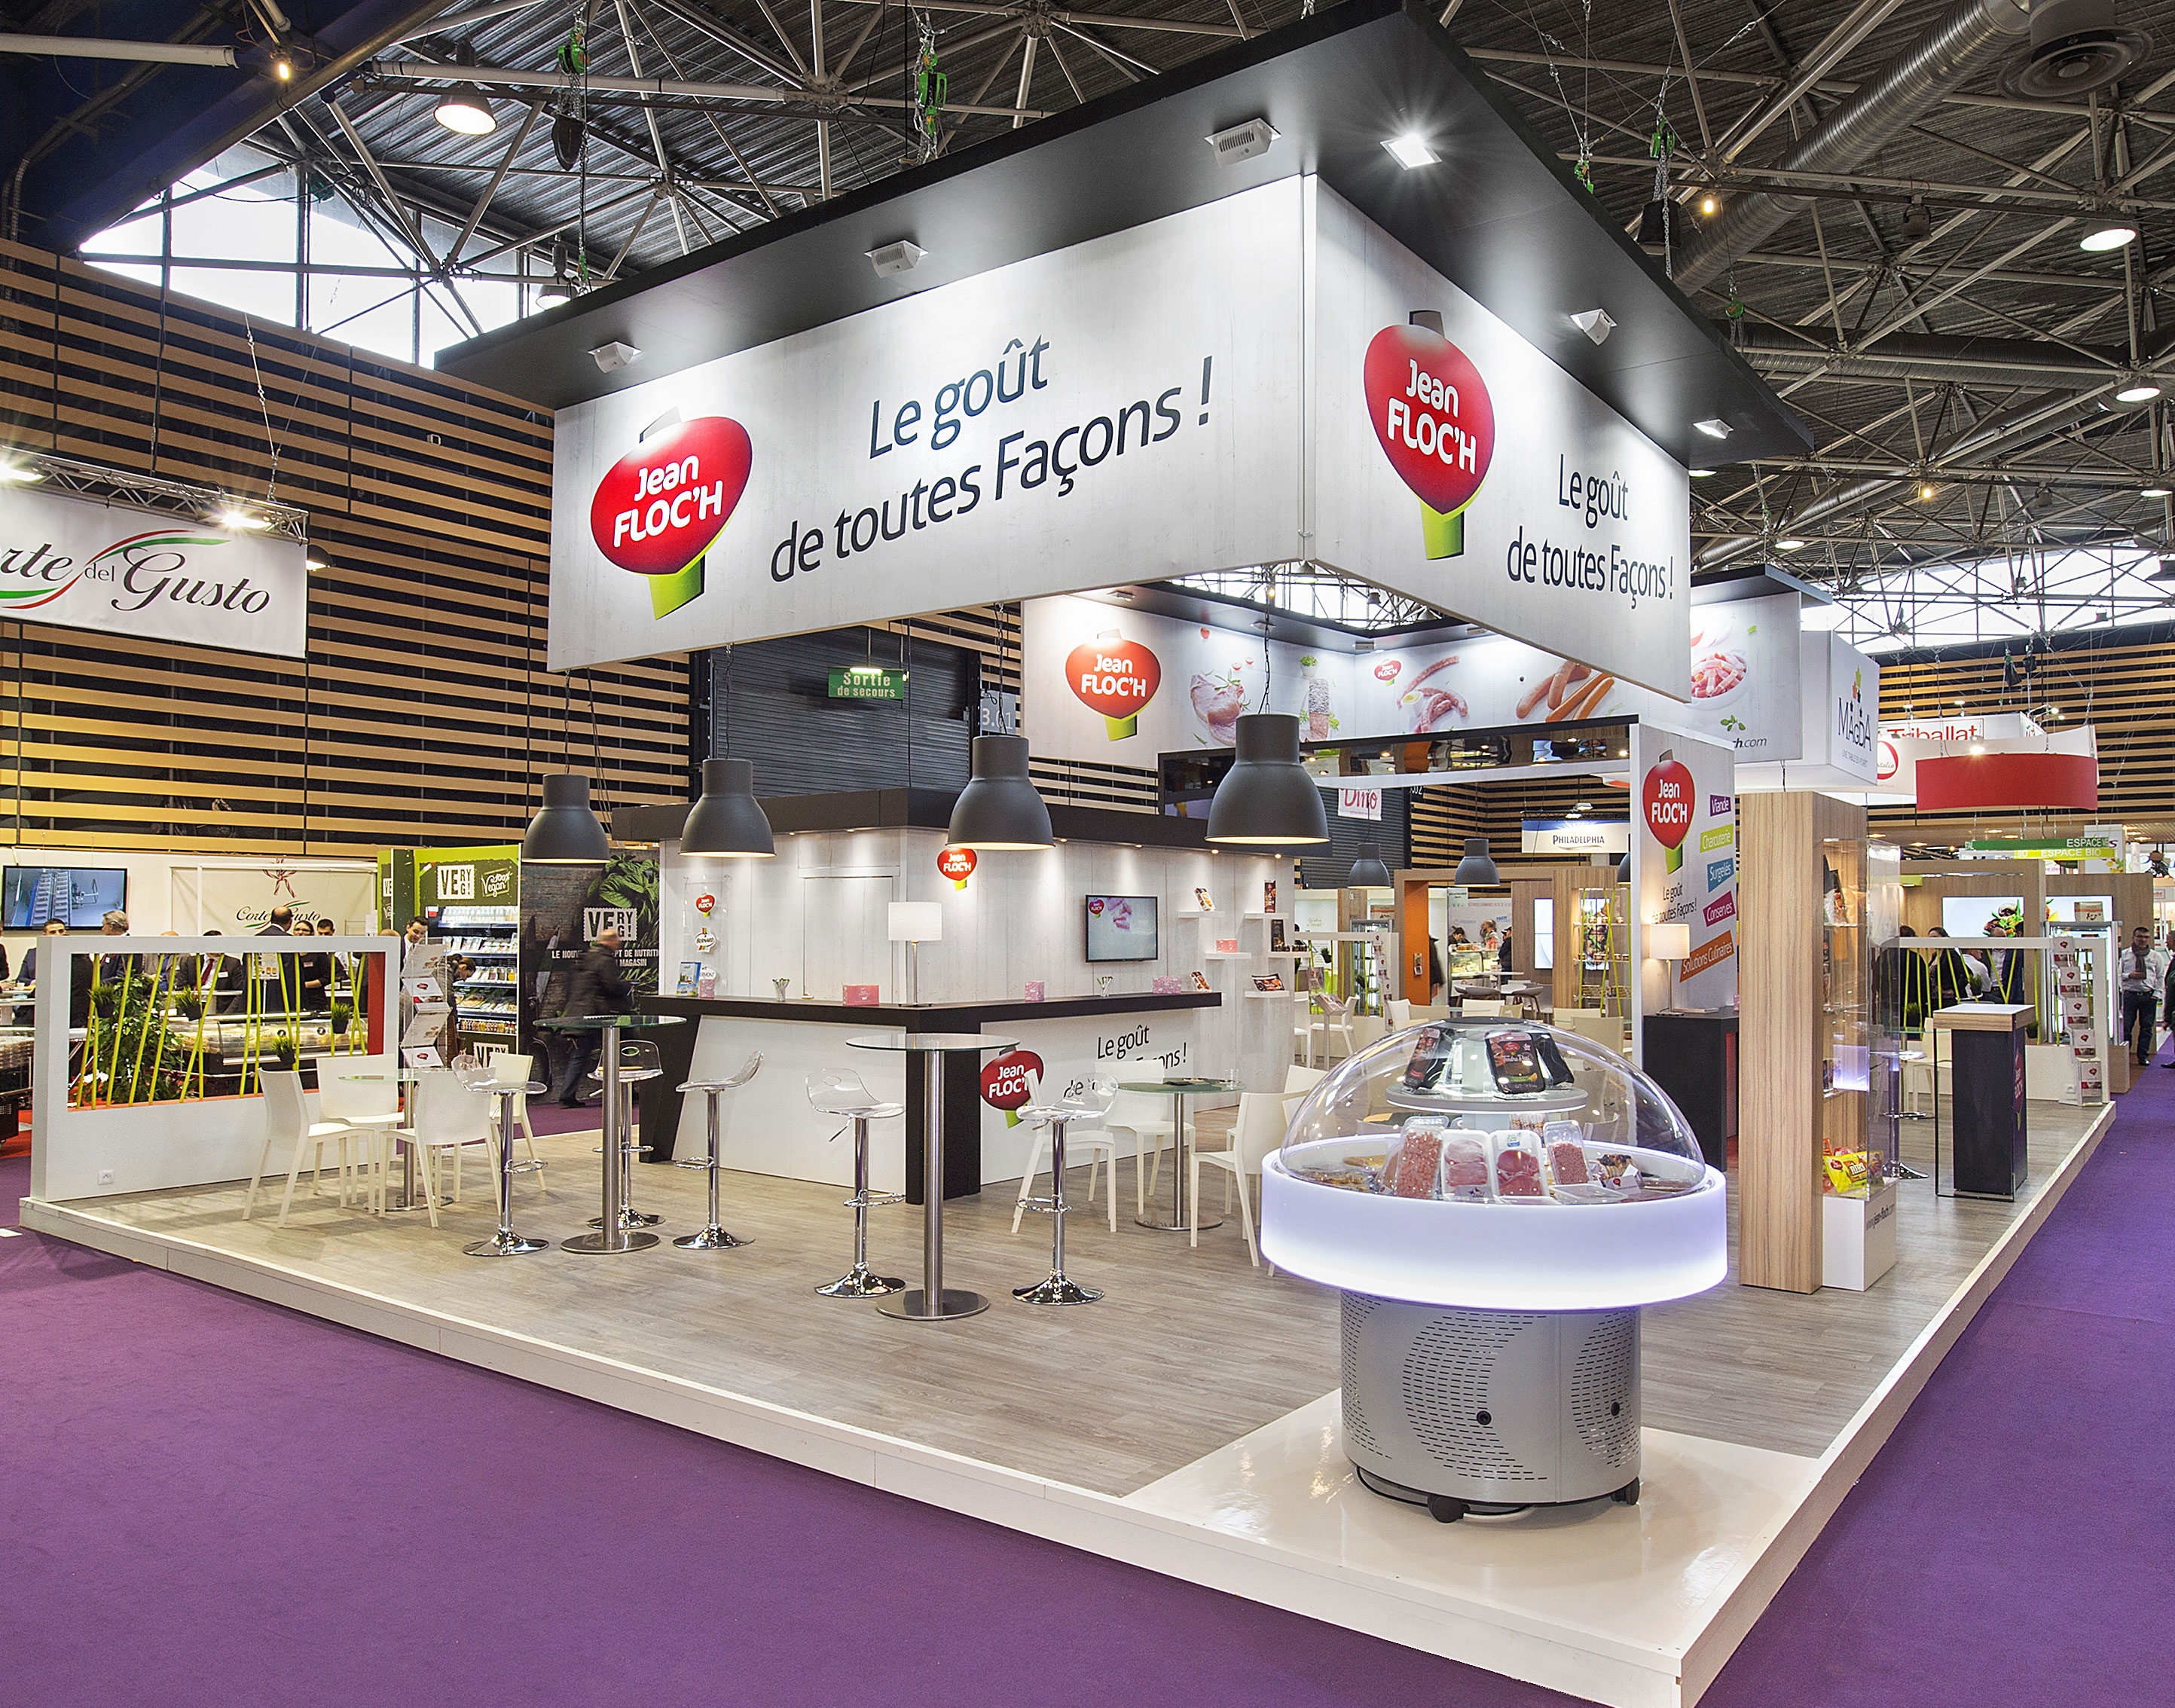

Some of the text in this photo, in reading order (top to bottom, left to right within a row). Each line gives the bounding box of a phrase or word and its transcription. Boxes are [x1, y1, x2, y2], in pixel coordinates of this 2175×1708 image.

[1405, 358, 1459, 418] Jean
[869, 338, 1051, 460] Le goût
[1387, 397, 1477, 475] FLOC'H
[634, 454, 700, 503] Jean
[770, 356, 1213, 582] de toutes Façons !
[1558, 453, 1629, 529] Le goût
[612, 478, 722, 549] FLOC'H
[0, 542, 270, 613] rte del Gusto
[1507, 525, 1673, 610] de toutes Façons !
[1093, 653, 1133, 674] Jean
[843, 671, 890, 686] Sortie
[1081, 674, 1147, 698] FLOC'H
[837, 685, 896, 698] de secours
[1732, 738, 1767, 748] h.com
[1658, 779, 1680, 799] Jean
[1651, 801, 1688, 823] FLOC'H
[1711, 797, 1729, 813] Viande
[1553, 835, 1605, 845] PHILADELPHIA
[1703, 829, 1731, 850] Charcuterie
[2067, 838, 2101, 847] ESPACE
[2041, 848, 2082, 857] ESPACE
[2085, 848, 2102, 857] BIO
[1709, 861, 1731, 883] Surgelés
[1663, 882, 1683, 903] Le goût
[236, 906, 321, 921] Corte usto
[1677, 900, 1695, 919] Façons
[1706, 903, 1733, 922] Conserves
[562, 950, 580, 958] NOUV
[625, 949, 634, 958] DE
[634, 949, 659, 958] NUTRITI
[619, 958, 647, 967] MAGASIN
[1682, 941, 1733, 974] Solutions Culinaires
[1097, 1024, 1150, 1060] Le goût
[997, 1064, 1025, 1080] Jean
